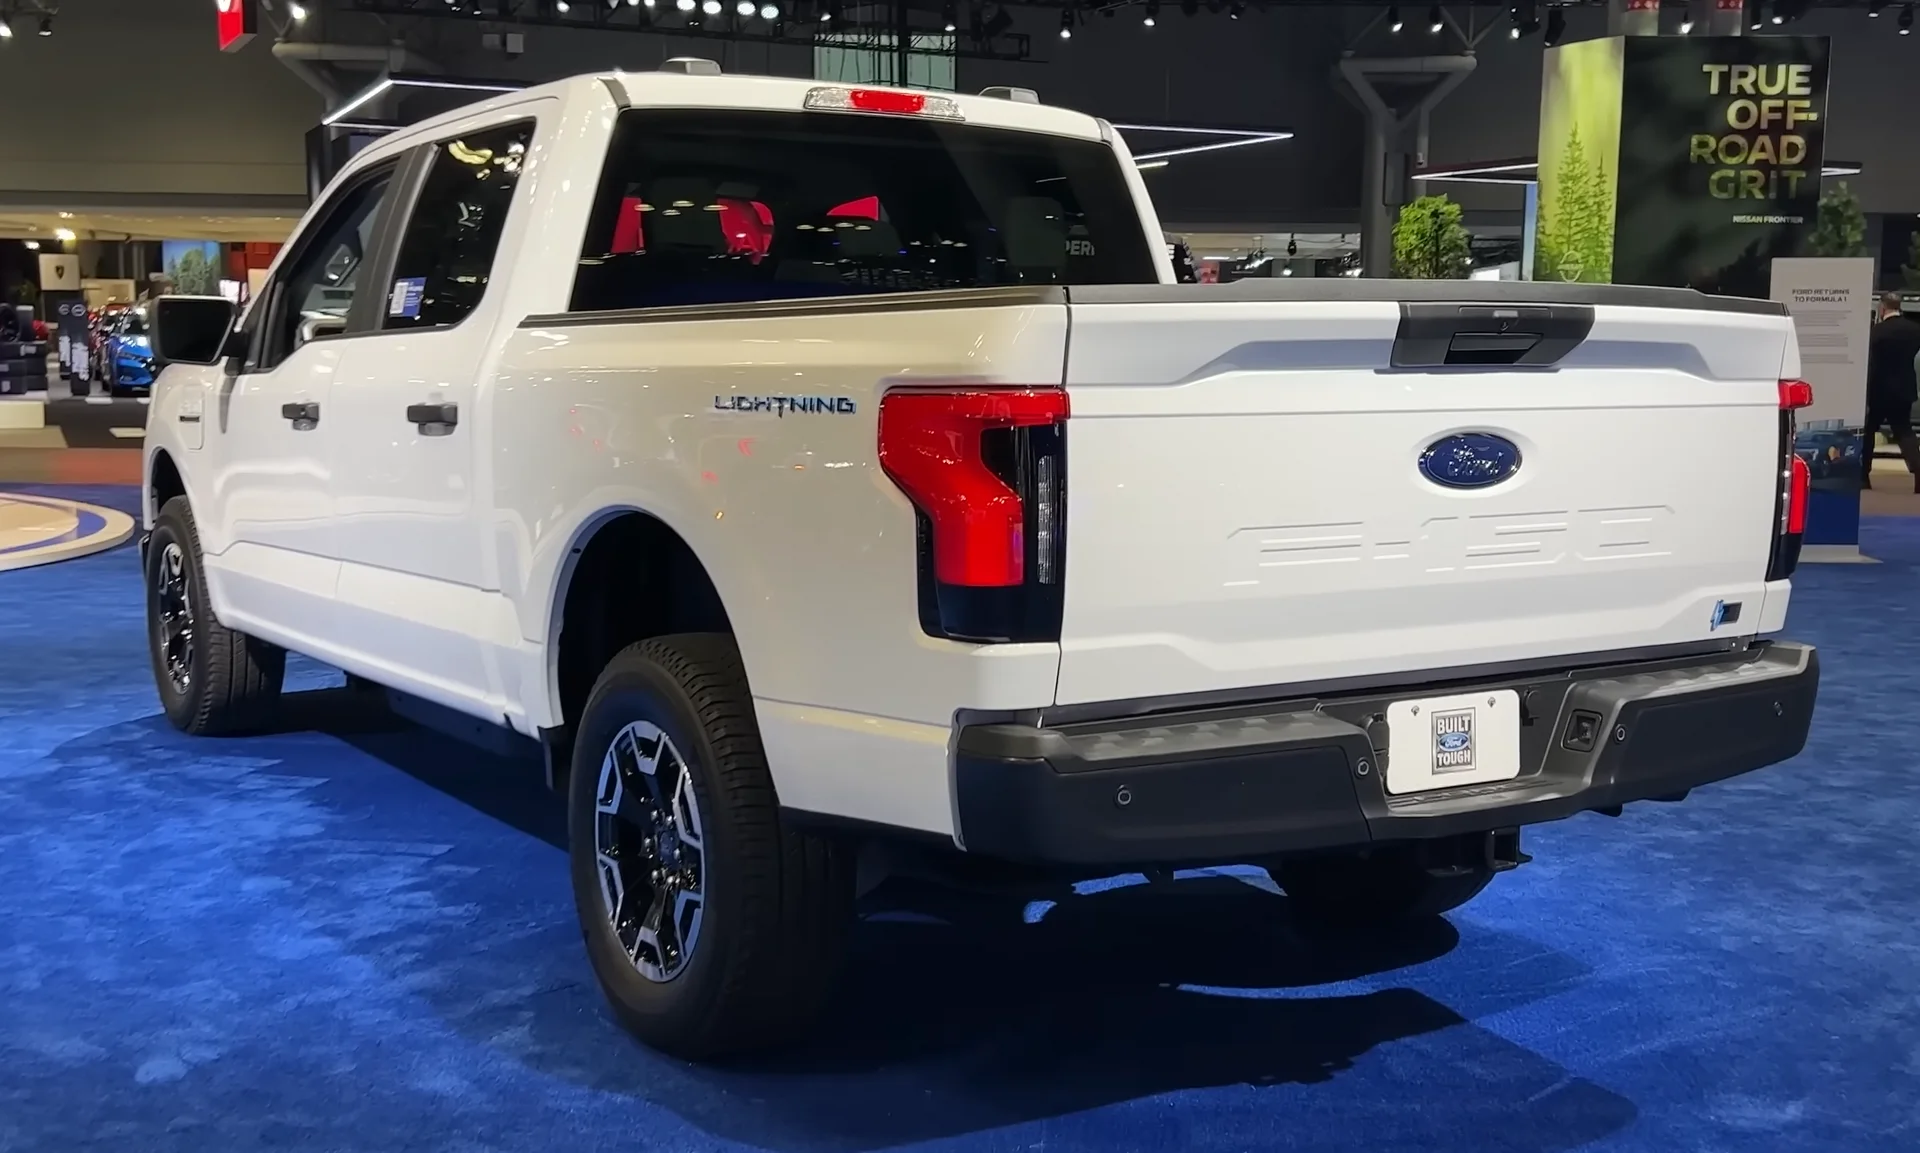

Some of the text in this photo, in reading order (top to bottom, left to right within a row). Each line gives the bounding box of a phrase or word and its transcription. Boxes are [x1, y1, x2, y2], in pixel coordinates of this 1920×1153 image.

[1702, 64, 1812, 95] TRUE
[1726, 99, 1819, 130] OFF-
[1689, 134, 1807, 165] ROAD
[1708, 169, 1807, 200] GRIT
[1732, 215, 1804, 224] NISSAN FRONTIER
[714, 395, 857, 419] LIGHTNING
[1437, 715, 1471, 735] BUILT
[1437, 749, 1471, 766] TOUGH
